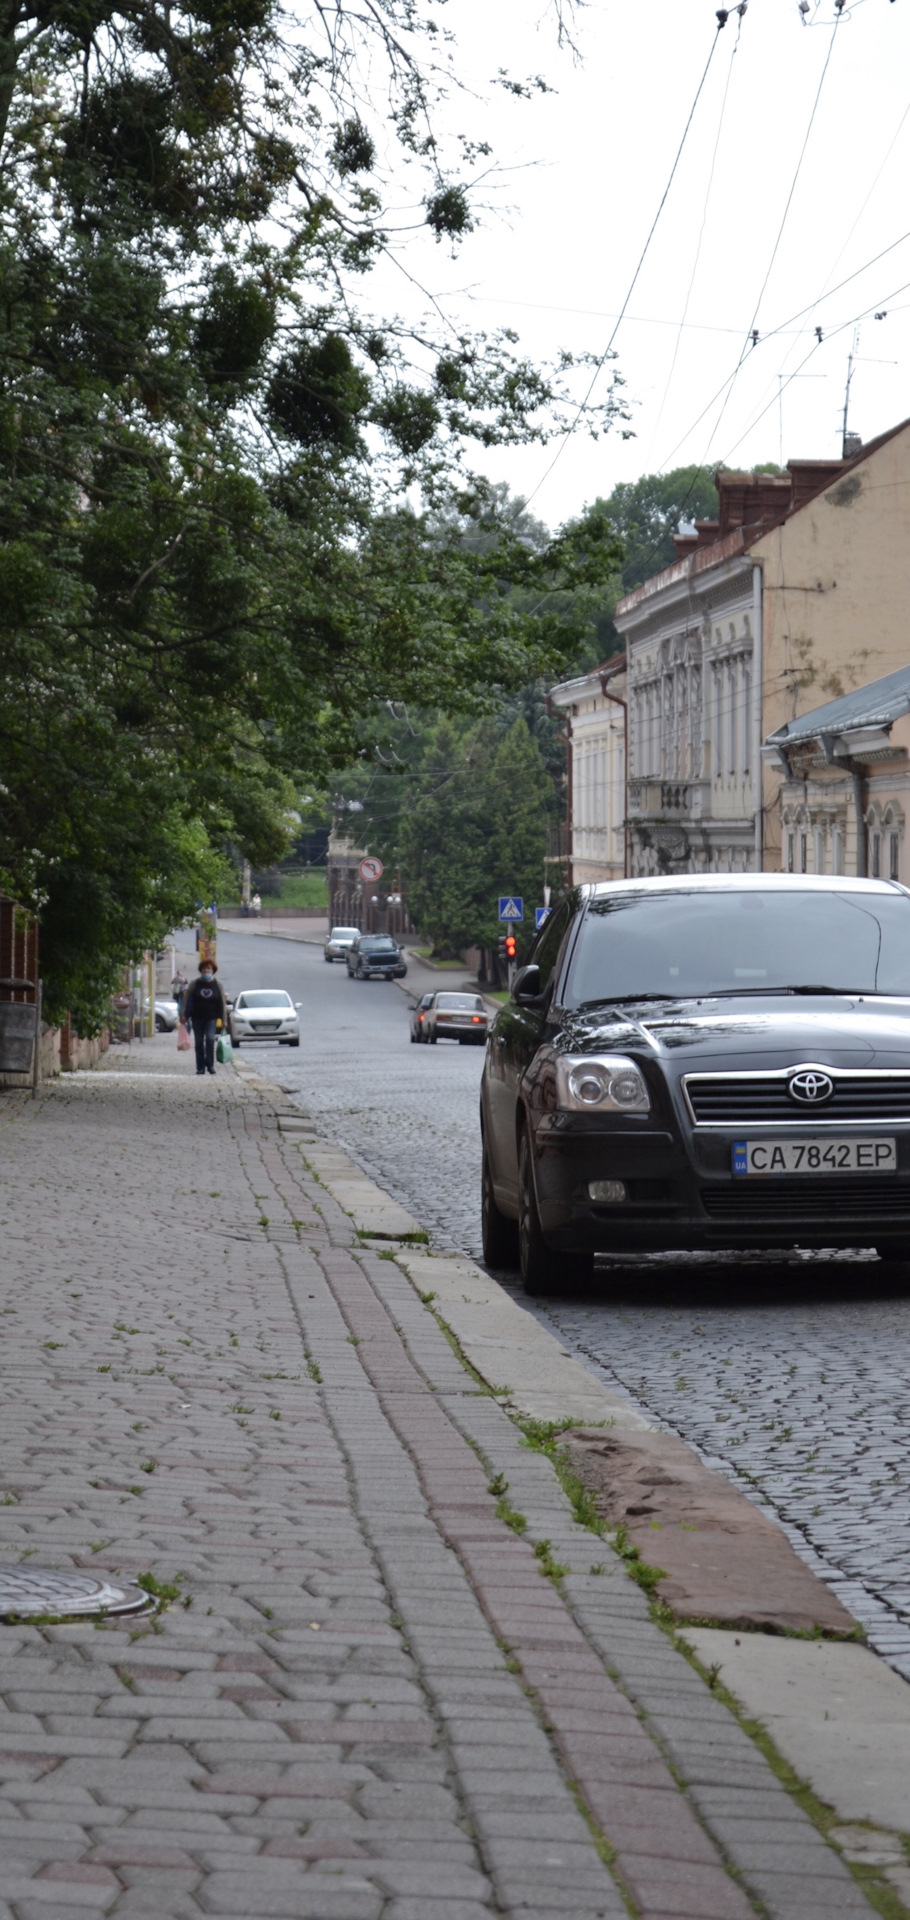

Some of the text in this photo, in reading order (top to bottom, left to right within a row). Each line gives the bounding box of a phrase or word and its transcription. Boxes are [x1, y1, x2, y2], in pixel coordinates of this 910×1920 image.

[751, 1143, 892, 1170] CA 7842 EP
[735, 1162, 747, 1170] UA
